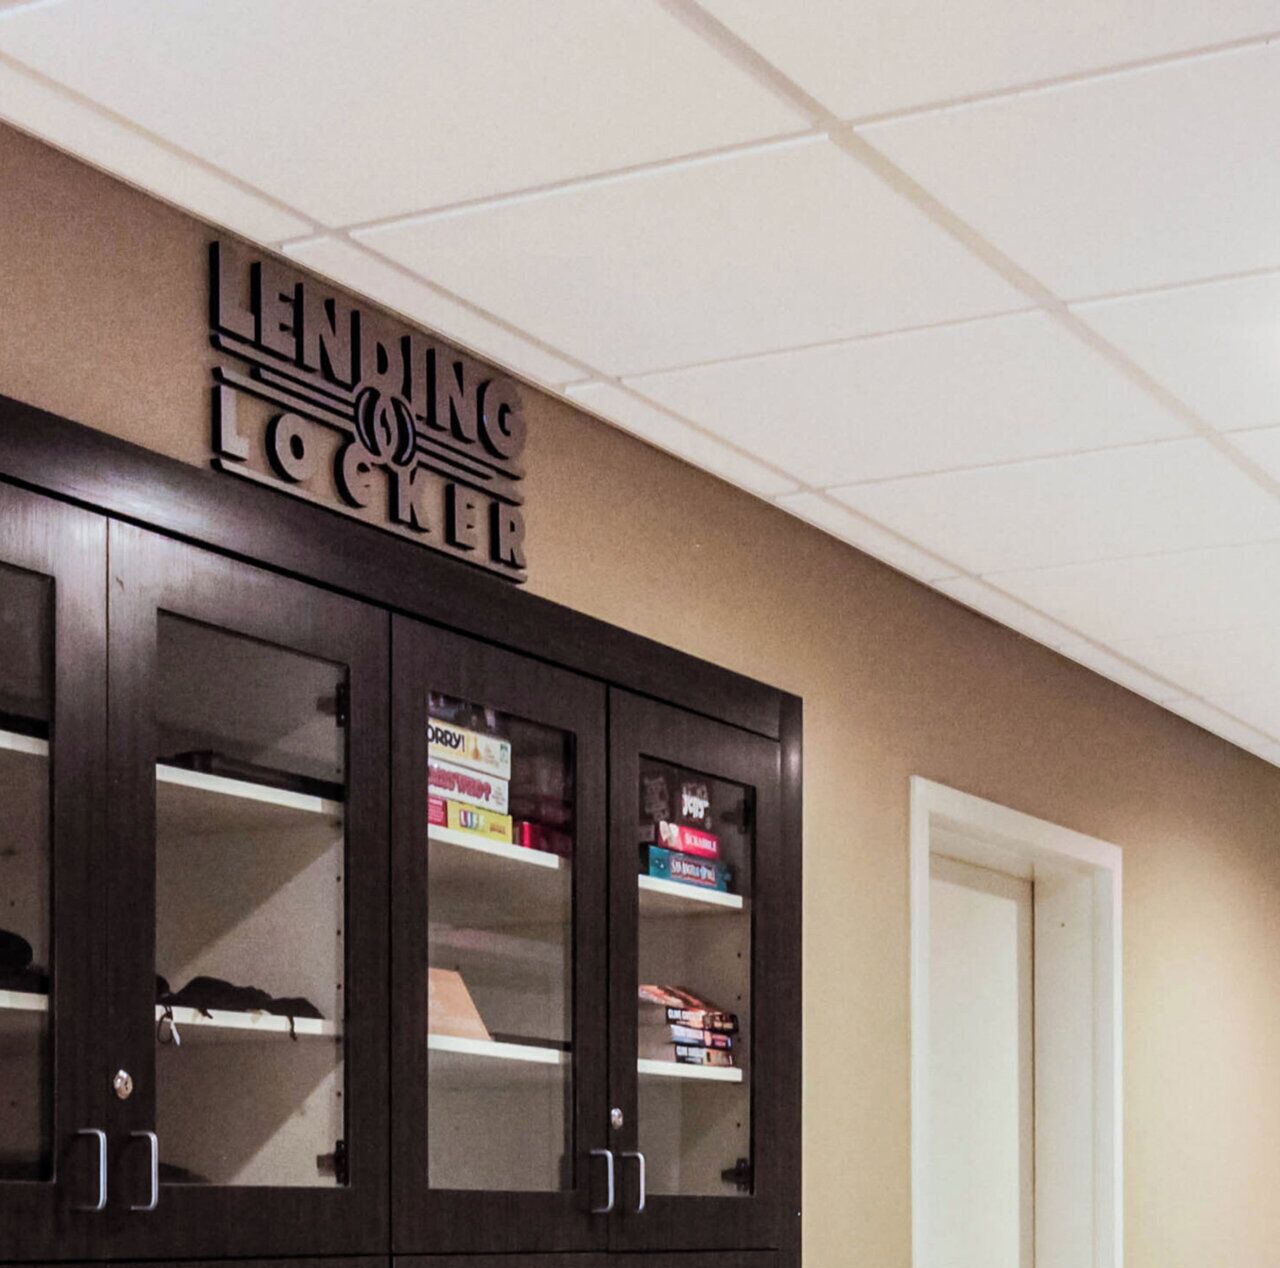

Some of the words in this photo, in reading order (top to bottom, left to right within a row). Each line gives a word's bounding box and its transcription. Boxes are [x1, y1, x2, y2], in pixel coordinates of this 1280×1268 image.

[209, 241, 525, 460] LENDING
[211, 383, 526, 569] LOCKER
[426, 724, 465, 752] ORRY!
